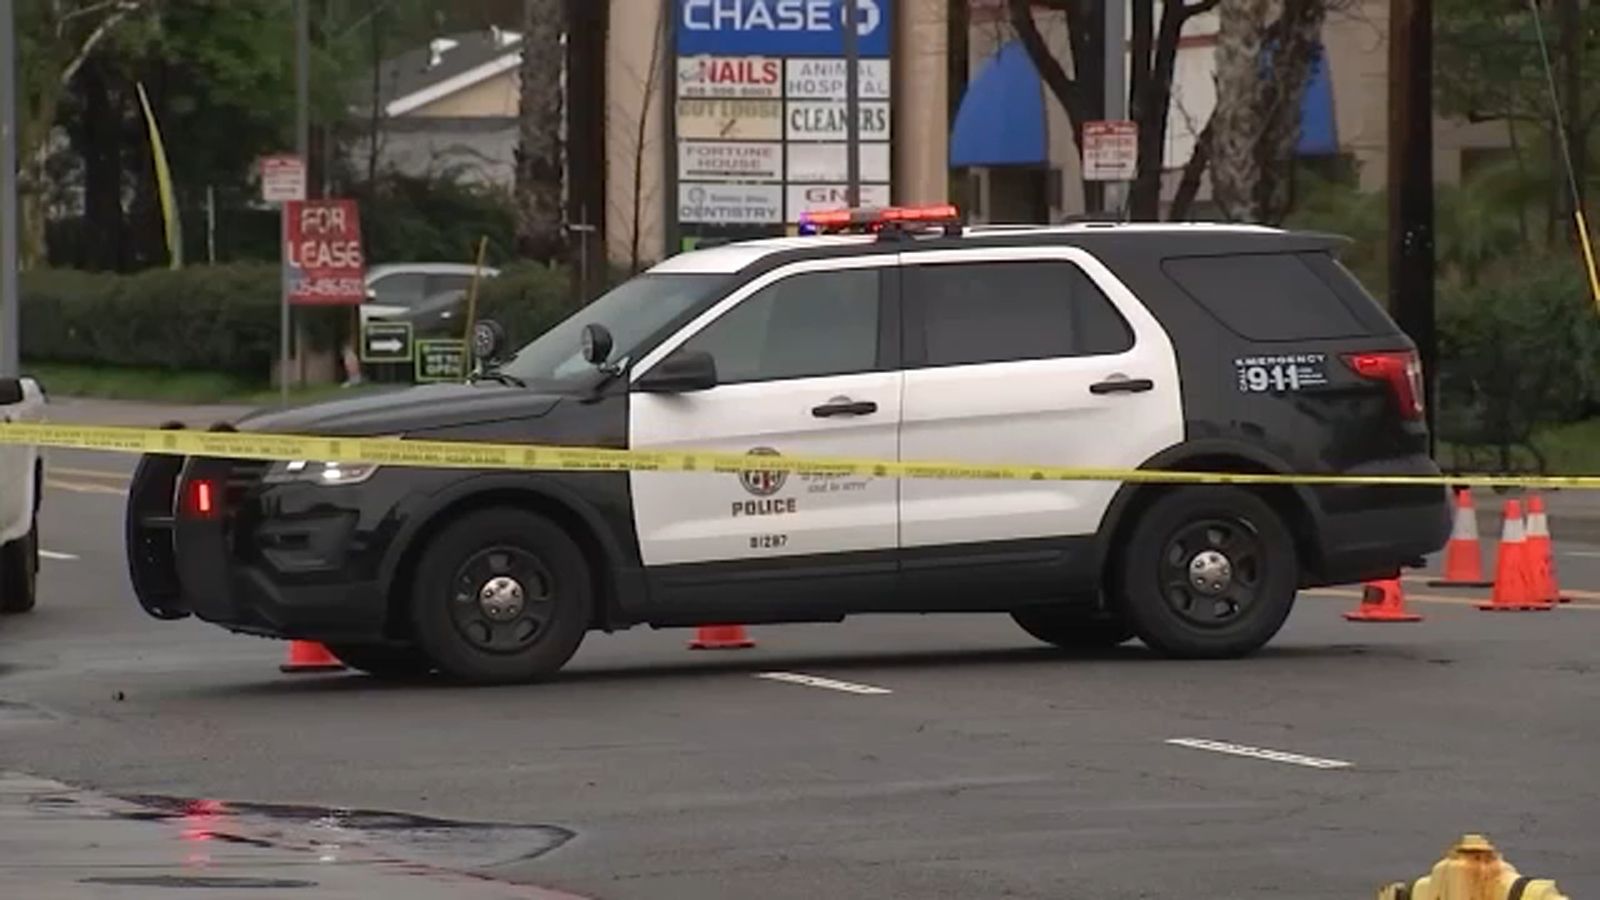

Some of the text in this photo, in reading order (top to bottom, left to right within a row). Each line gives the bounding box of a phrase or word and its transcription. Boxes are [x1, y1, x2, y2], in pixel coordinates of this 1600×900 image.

[683, 0, 833, 31] CHASE
[699, 61, 778, 84] NAILS
[789, 81, 887, 95] HOSPAL
[687, 147, 772, 158] FORTUNE
[698, 159, 761, 169] HOUSE
[301, 207, 346, 234] FOR
[681, 206, 777, 219] DENTISTRY
[288, 241, 362, 269] LEASE
[1235, 354, 1325, 366] EMERGENCY
[731, 498, 797, 517] POLICE
